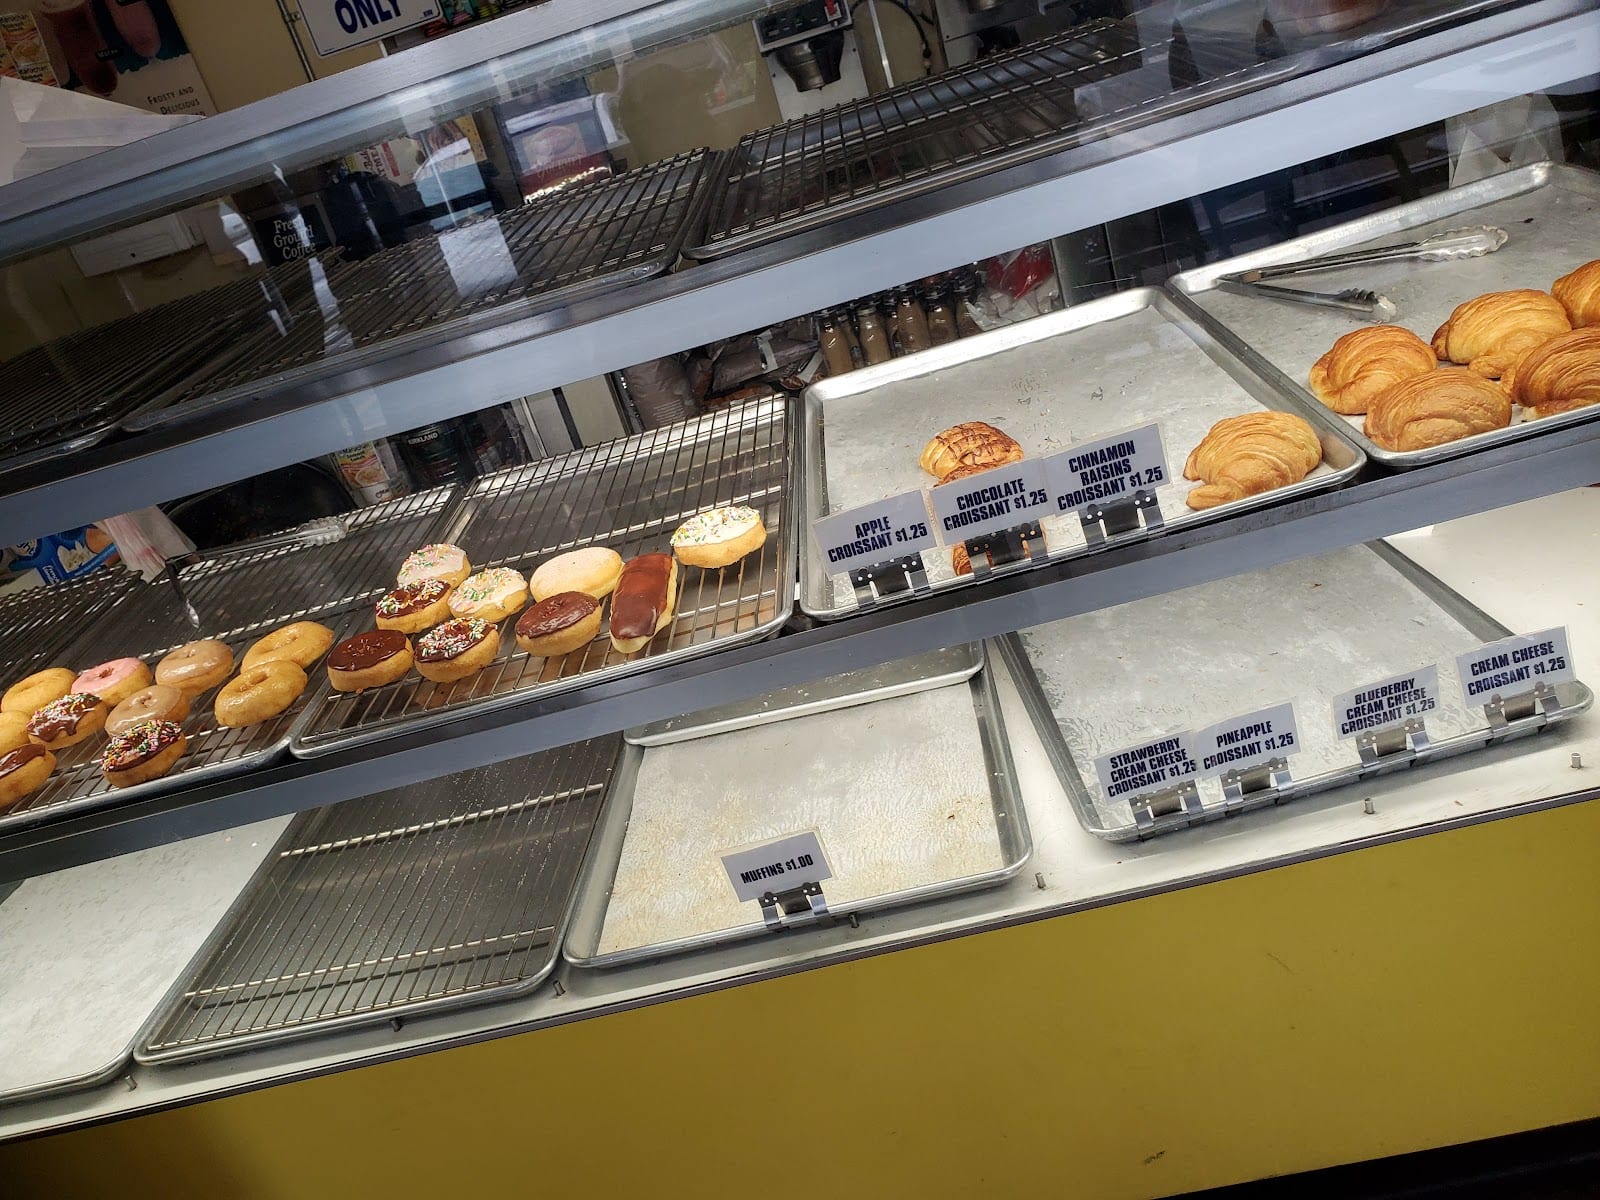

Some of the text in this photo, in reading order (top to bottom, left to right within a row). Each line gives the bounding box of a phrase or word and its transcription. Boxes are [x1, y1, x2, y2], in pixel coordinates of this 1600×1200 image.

[335, 0, 402, 34] ONLY
[282, 243, 316, 260] Coffee
[1068, 440, 1136, 473] CINNAMON
[1079, 458, 1132, 486] RAISINS
[956, 478, 1026, 511] CHOCOLATE
[1057, 465, 1163, 511] CROISSANT $1.25
[943, 488, 1048, 531] CROISSANT $1.25
[827, 522, 928, 563] CROISSANT $1.25
[855, 516, 891, 539] APPLE
[1470, 641, 1555, 676] CREAM CHEESE
[1354, 678, 1415, 705] BLUEBERRY
[1467, 656, 1566, 696] CROISSANT $1.25
[1341, 697, 1435, 735] CROISSANT $1.25
[1346, 687, 1427, 720] CREAM CHEESE
[1203, 732, 1294, 770] CROISSANT $1.25
[1216, 721, 1273, 748] PINEAPPLE
[1110, 737, 1181, 769] STRAWBERRY
[1110, 749, 1189, 783] CREAM CHEESE
[1107, 760, 1197, 797] CROISSANT $1.25
[740, 854, 814, 884] MUFFINS $1.00
